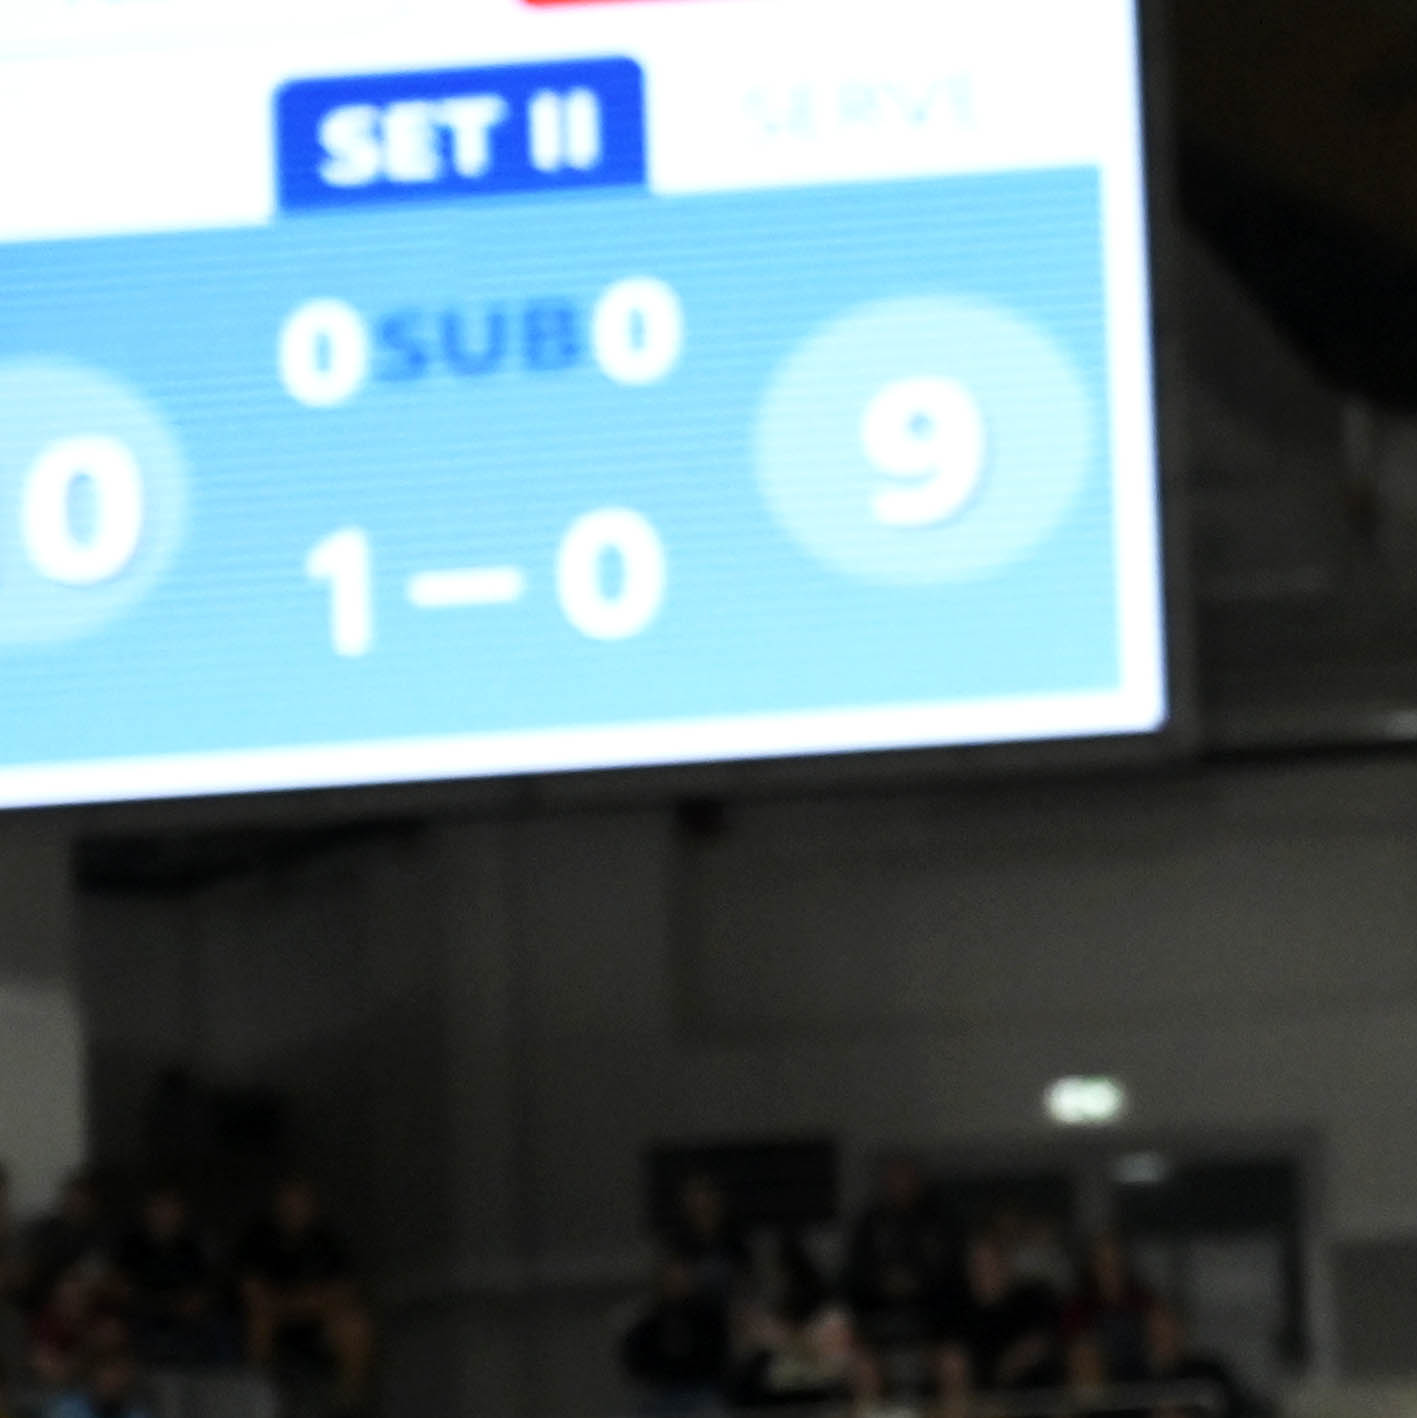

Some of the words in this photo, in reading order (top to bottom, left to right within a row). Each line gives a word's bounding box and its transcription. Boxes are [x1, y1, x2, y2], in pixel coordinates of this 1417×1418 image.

[316, 92, 508, 190] SET
[524, 84, 603, 176] II
[277, 296, 369, 409] 0
[374, 298, 583, 384] SUB
[592, 275, 685, 387] 0
[20, 432, 146, 587] 0
[860, 374, 985, 530] 9
